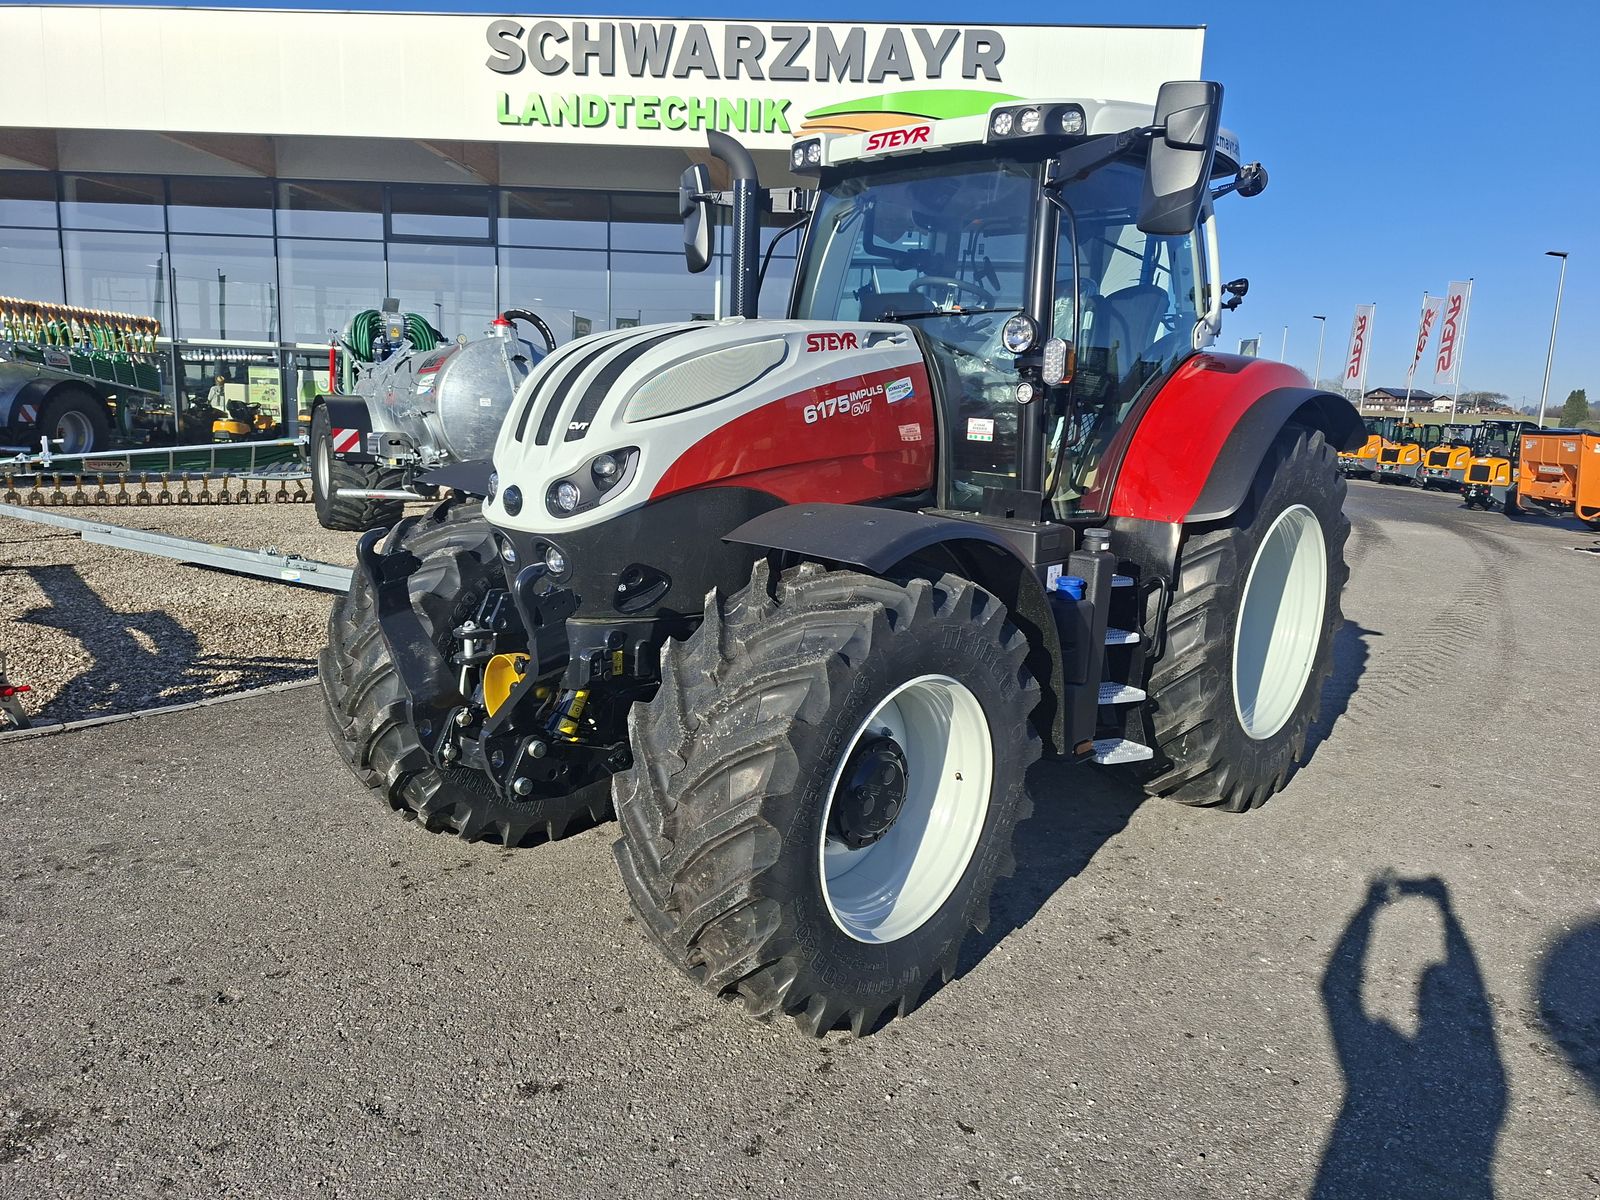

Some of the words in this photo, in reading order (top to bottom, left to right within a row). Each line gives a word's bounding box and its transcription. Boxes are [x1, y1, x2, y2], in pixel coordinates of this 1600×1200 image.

[485, 19, 1005, 83] SCHWARZMAYR
[496, 91, 792, 133] LANDTECHNIK
[866, 126, 930, 151] STEYR
[806, 332, 859, 352] STEYR
[803, 394, 851, 424] 6175
[849, 384, 884, 402] IMPULS
[851, 399, 872, 417] CVT
[568, 421, 590, 430] CVT
